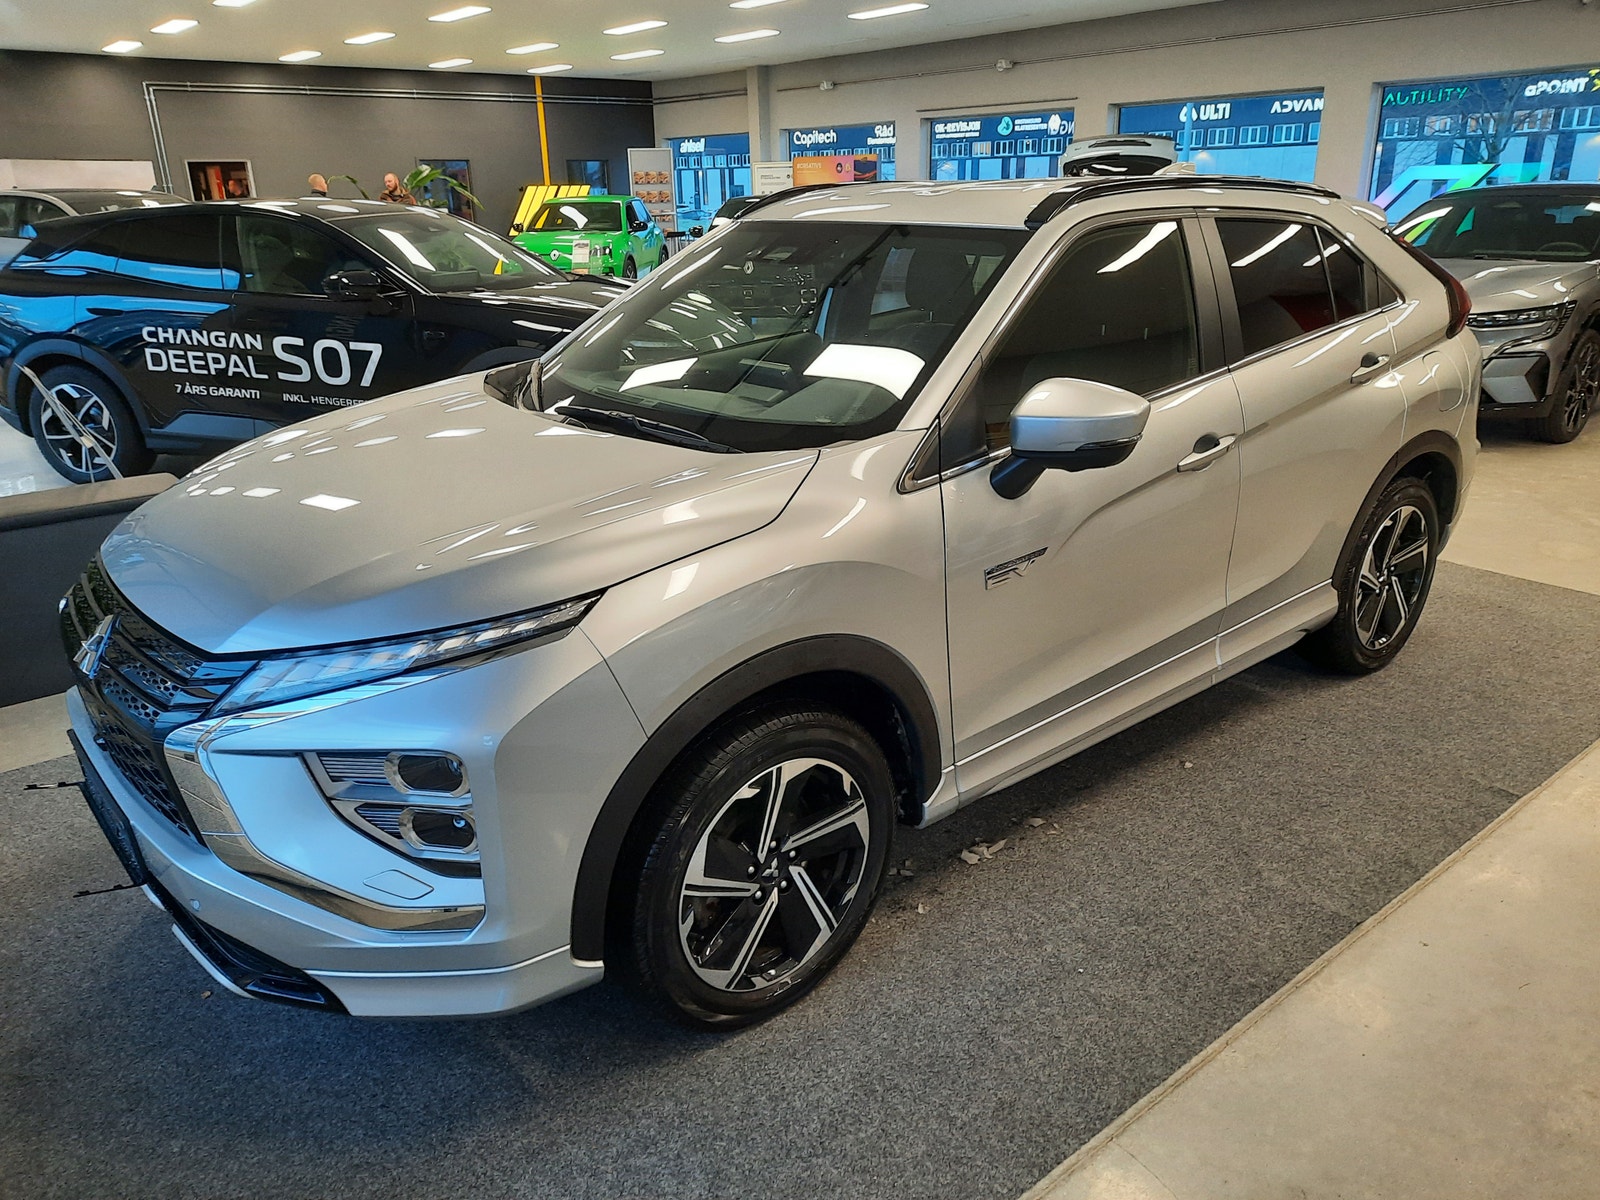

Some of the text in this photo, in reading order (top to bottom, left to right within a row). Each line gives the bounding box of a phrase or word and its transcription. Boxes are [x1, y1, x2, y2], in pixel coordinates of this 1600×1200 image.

[142, 326, 263, 350] CHANGAN
[144, 336, 382, 387] DEEPAL S07
[174, 382, 260, 399] 7 ÅRS GARANTI
